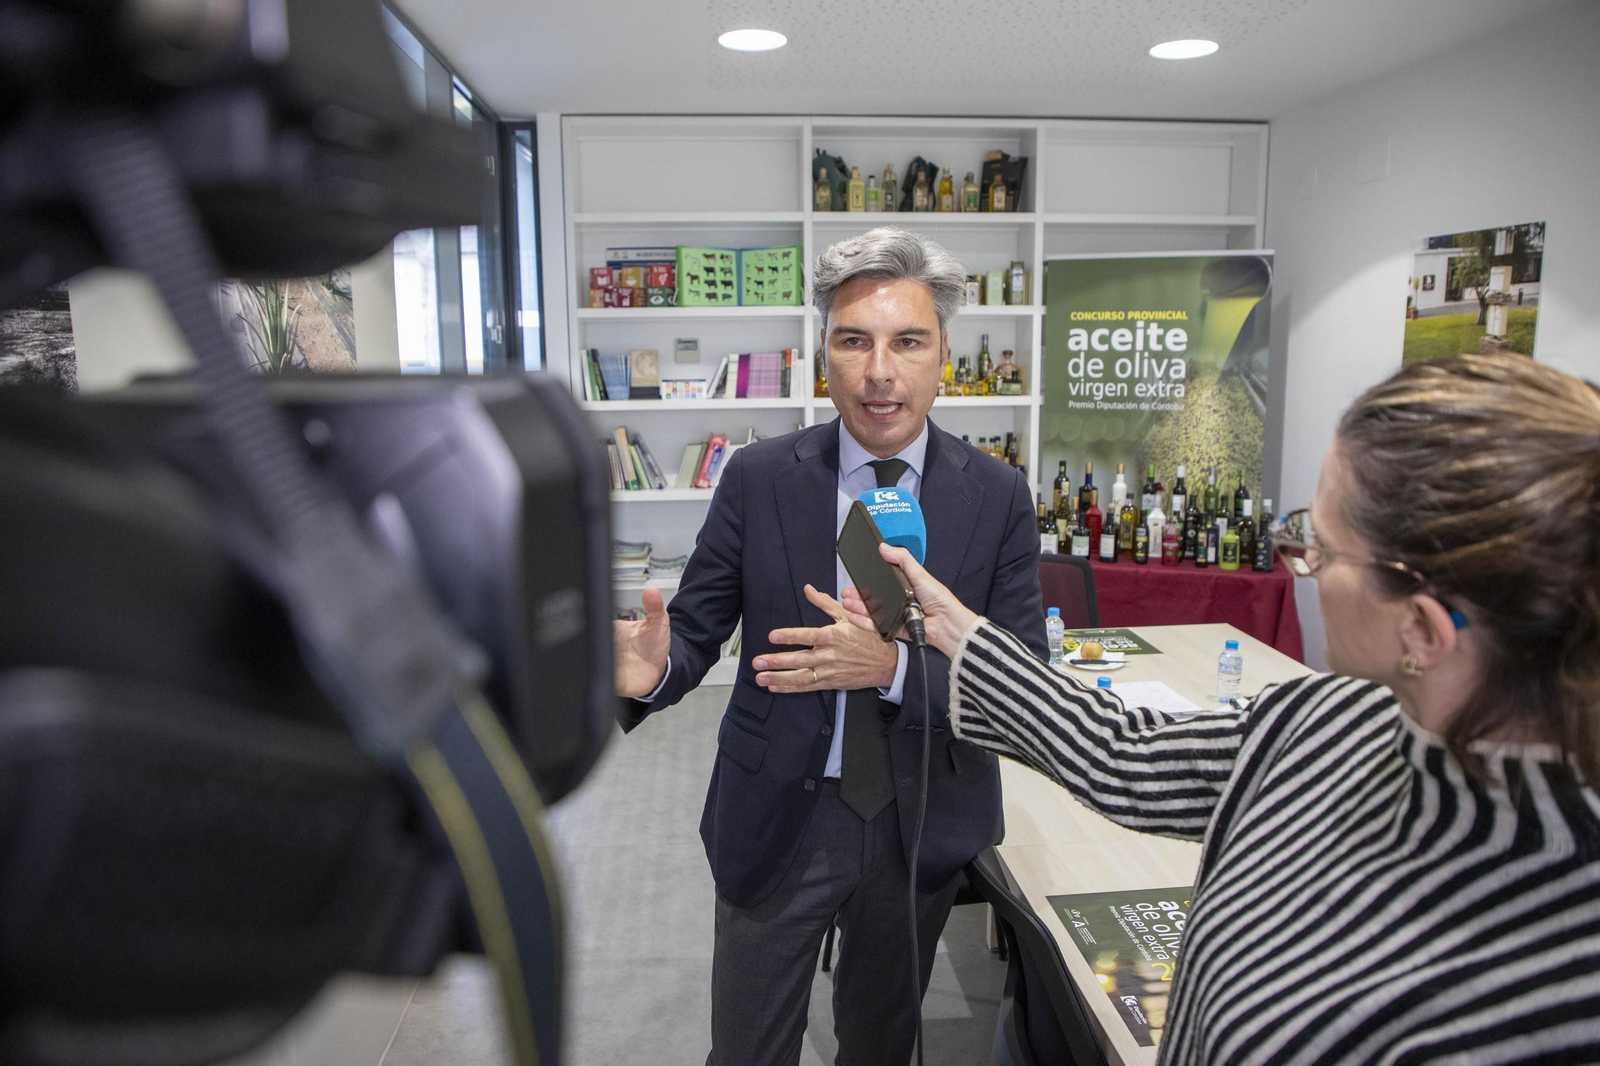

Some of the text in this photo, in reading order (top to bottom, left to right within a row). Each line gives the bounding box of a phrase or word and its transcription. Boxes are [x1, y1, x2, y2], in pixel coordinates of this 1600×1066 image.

[1070, 310, 1188, 320] CONCURSO PROVINCIAL
[1067, 320, 1188, 352] aceite
[1068, 351, 1186, 379] de oliva
[1068, 378, 1185, 400] virgen extra
[1068, 400, 1185, 410] Premio Diputación de Córdoba
[866, 502, 911, 512] Diputación
[1136, 902, 1161, 920] de
[1120, 904, 1170, 960] virgen extra
[1151, 961, 1177, 981] 2
